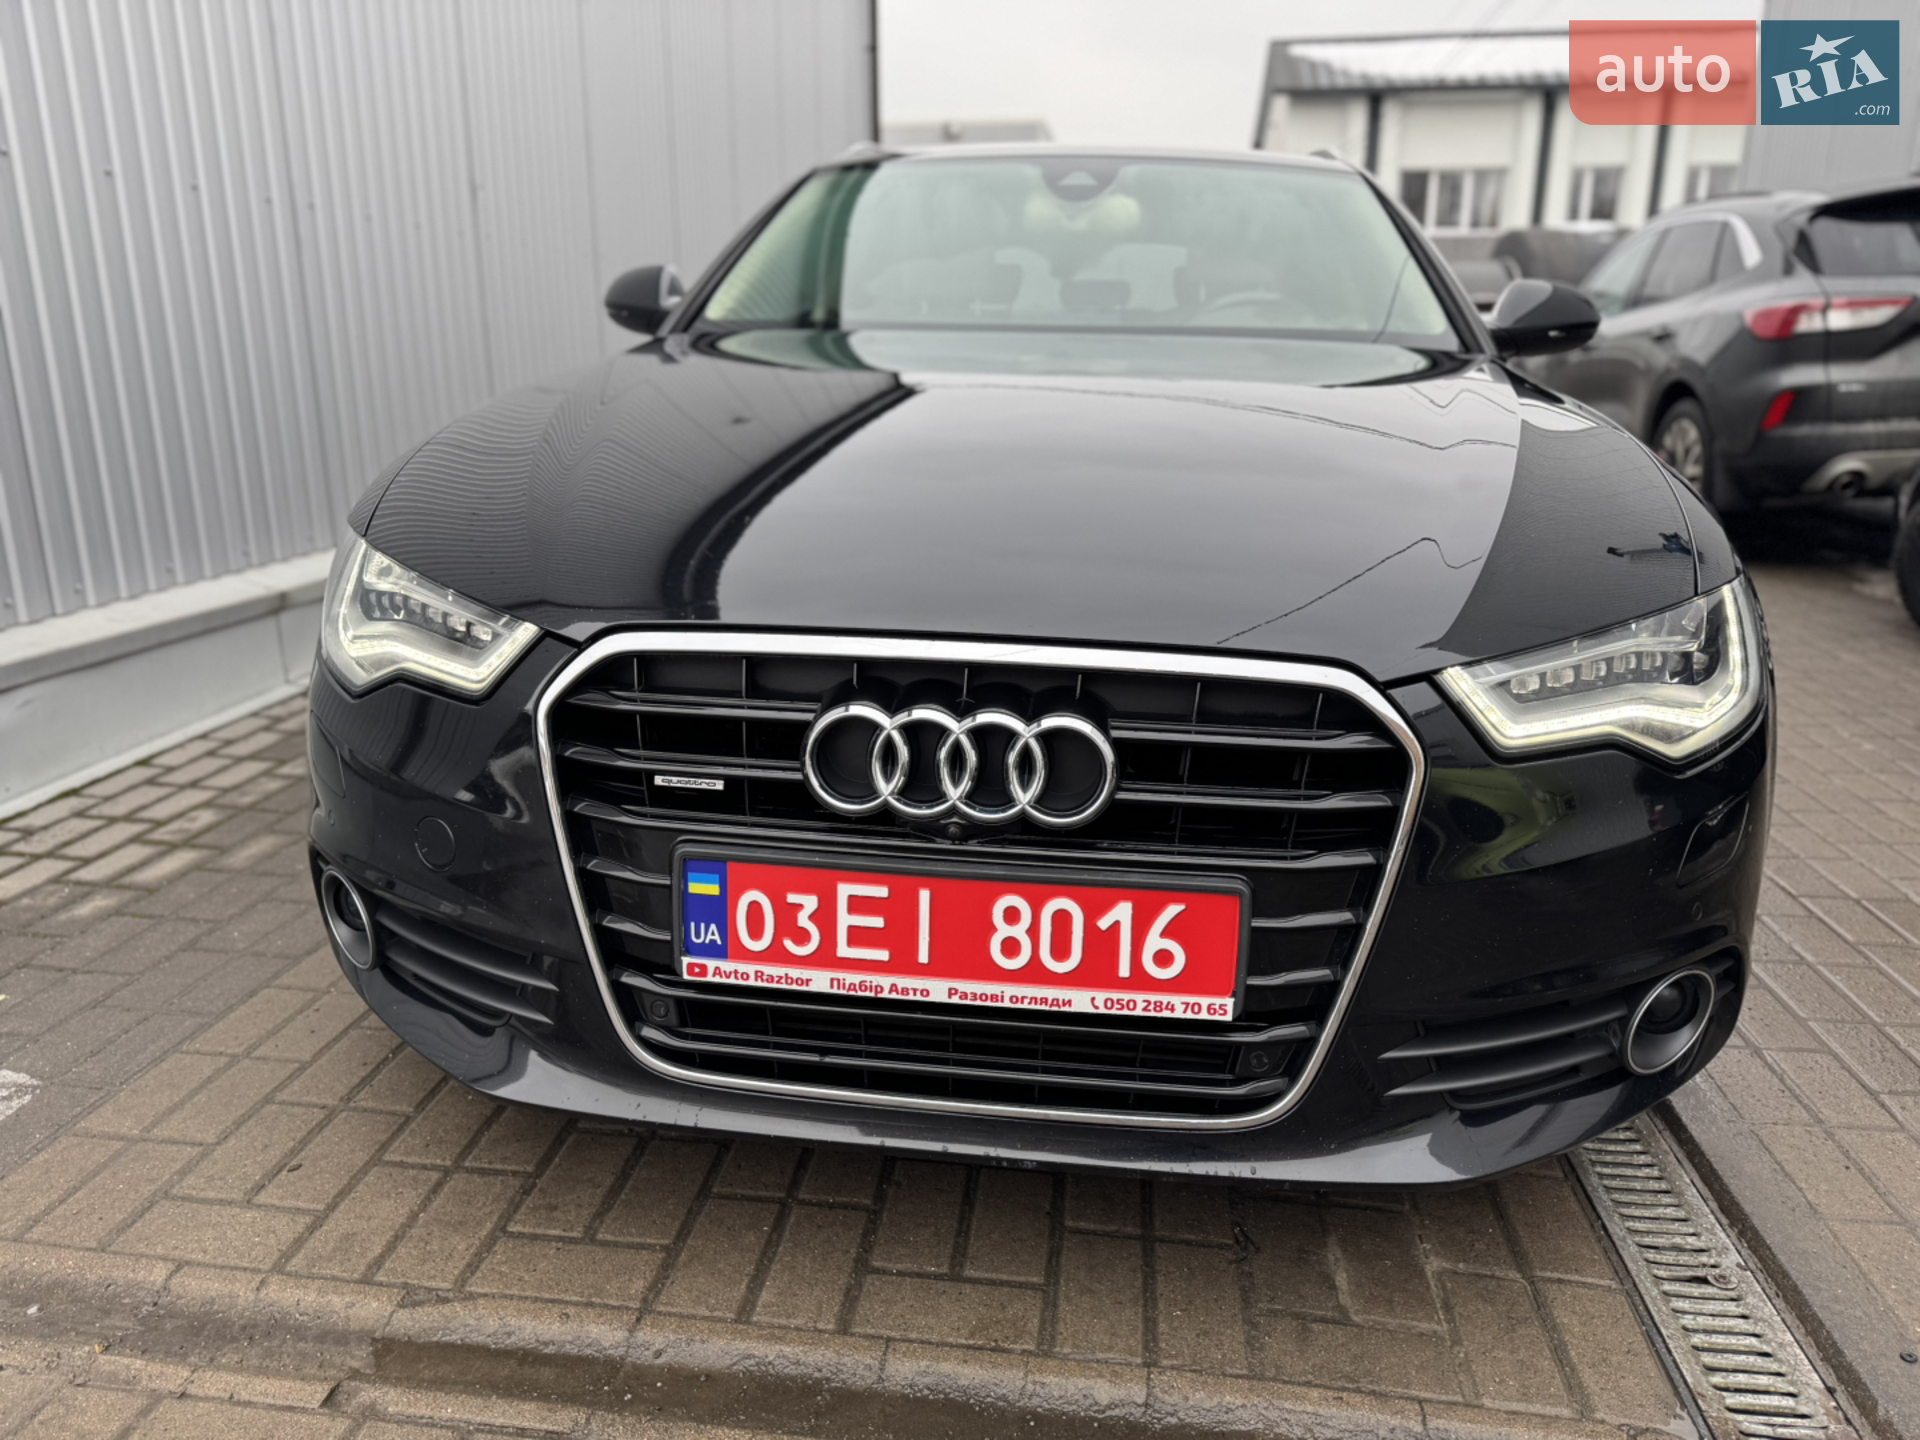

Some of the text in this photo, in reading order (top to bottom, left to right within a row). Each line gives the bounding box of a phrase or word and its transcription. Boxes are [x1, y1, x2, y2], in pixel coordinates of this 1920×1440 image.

[661, 778, 716, 787] quattro
[690, 921, 722, 945] UA
[735, 882, 1187, 981] 03EI 8016
[712, 966, 813, 988] Avto Razbor
[829, 977, 1073, 1009] Підбір Авто Разові огляди
[1103, 997, 1228, 1016] 050 284 70 65
